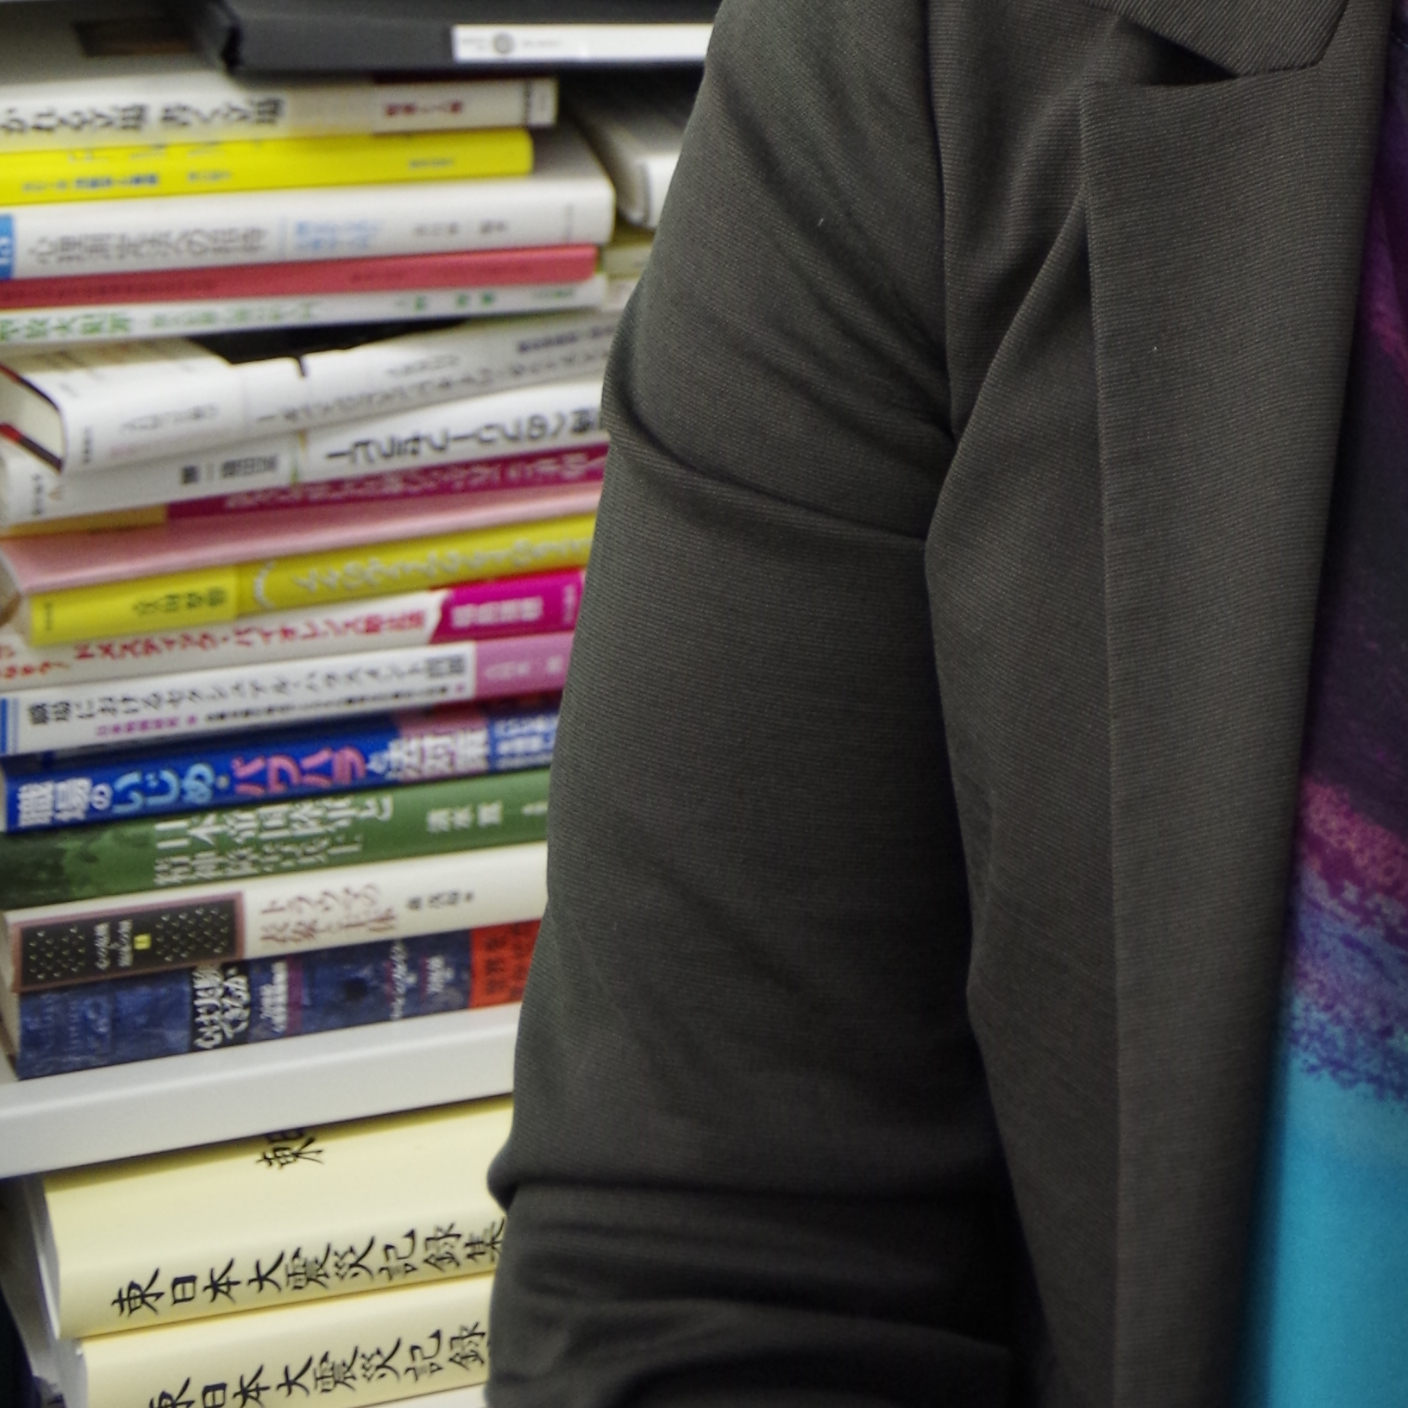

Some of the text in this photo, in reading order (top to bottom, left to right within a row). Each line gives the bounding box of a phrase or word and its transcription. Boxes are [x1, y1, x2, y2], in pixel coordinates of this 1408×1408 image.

[26, 649, 469, 727] 職場におけるセクシュアル・ハラスメント問題
[17, 723, 490, 829] 職場のいじめ・パワハラと法対策
[155, 795, 394, 851] 日本帝国陸軍と
[260, 882, 382, 917] トラウマの
[111, 1215, 505, 1318] 東日本大震災記録集
